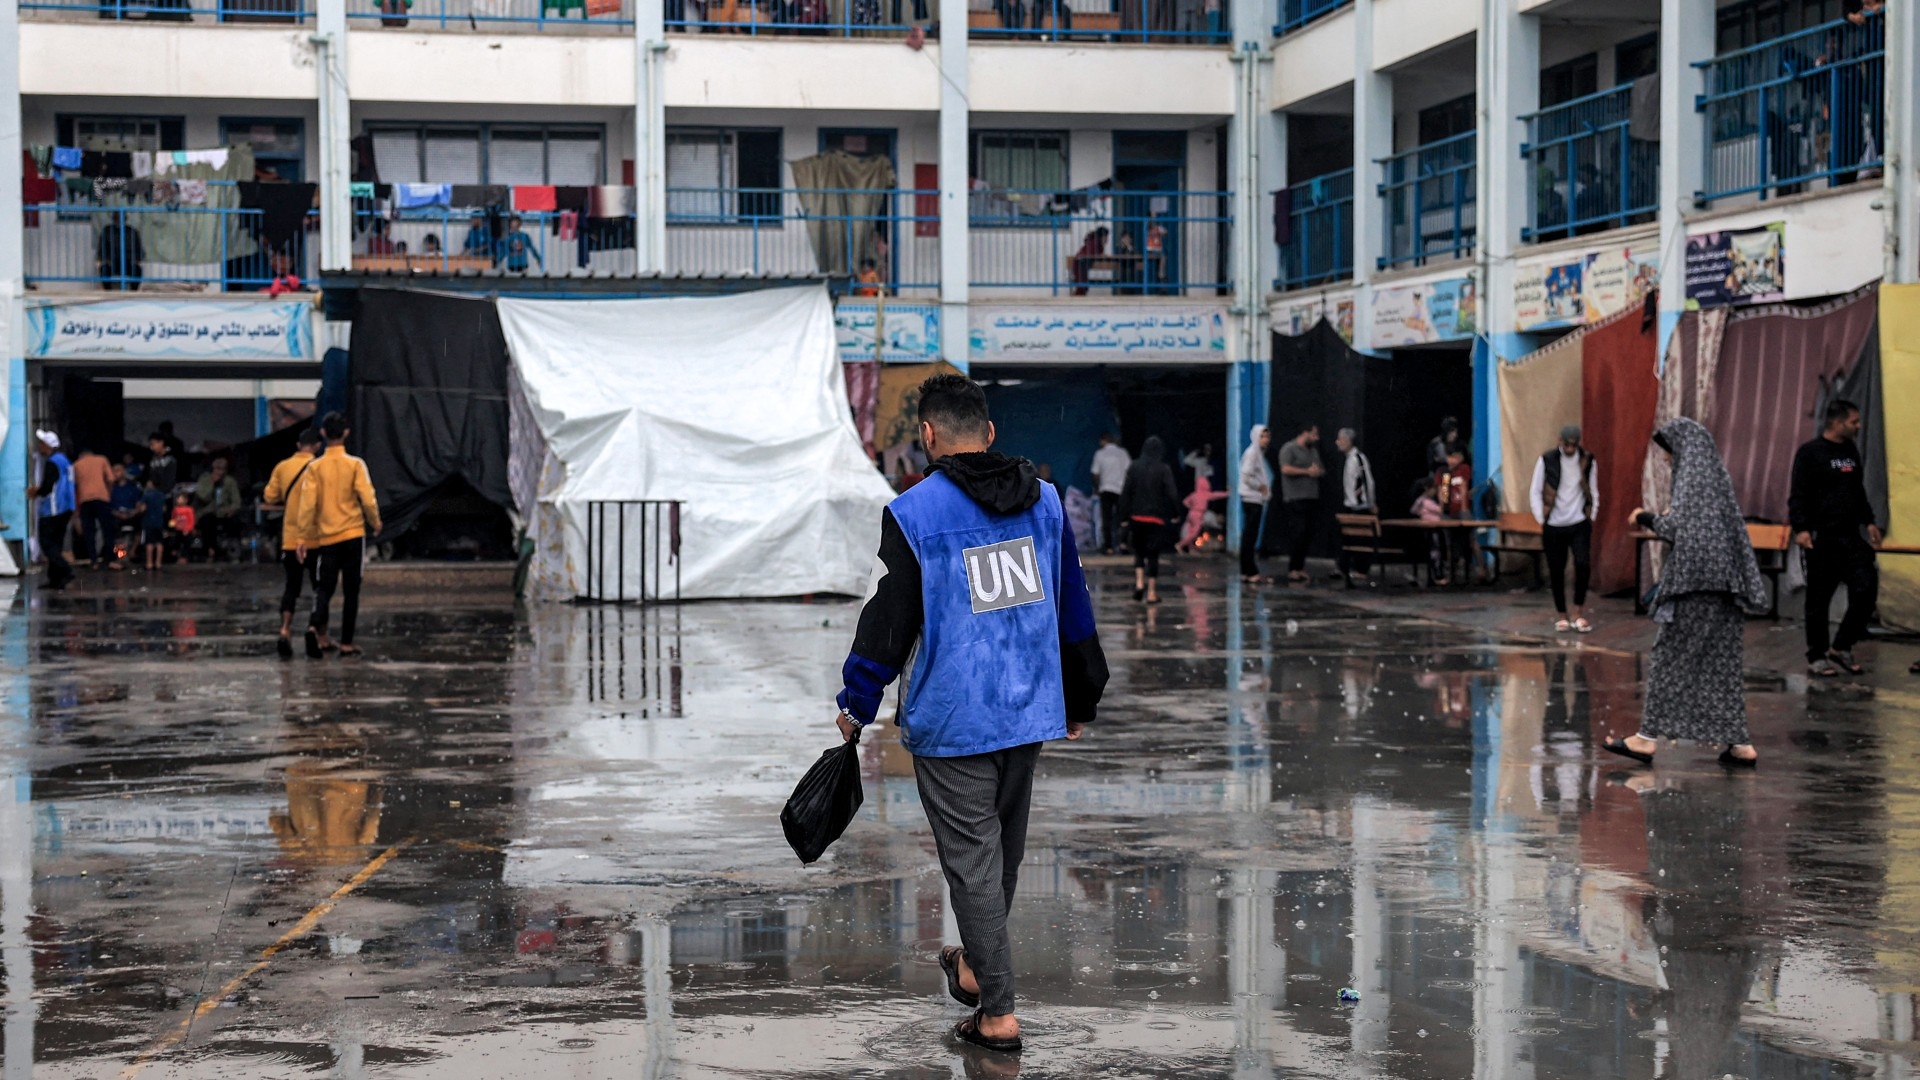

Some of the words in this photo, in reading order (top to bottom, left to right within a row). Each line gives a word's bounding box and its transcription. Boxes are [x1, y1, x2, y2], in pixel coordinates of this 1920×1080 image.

[105, 321, 141, 339] دراسته
[143, 320, 156, 342] في
[157, 321, 194, 340] المتفوق
[195, 325, 209, 340] هو
[211, 320, 246, 342] المثالي
[247, 322, 285, 341] الطالب
[1124, 335, 1145, 352] في
[969, 545, 1038, 602] UN
